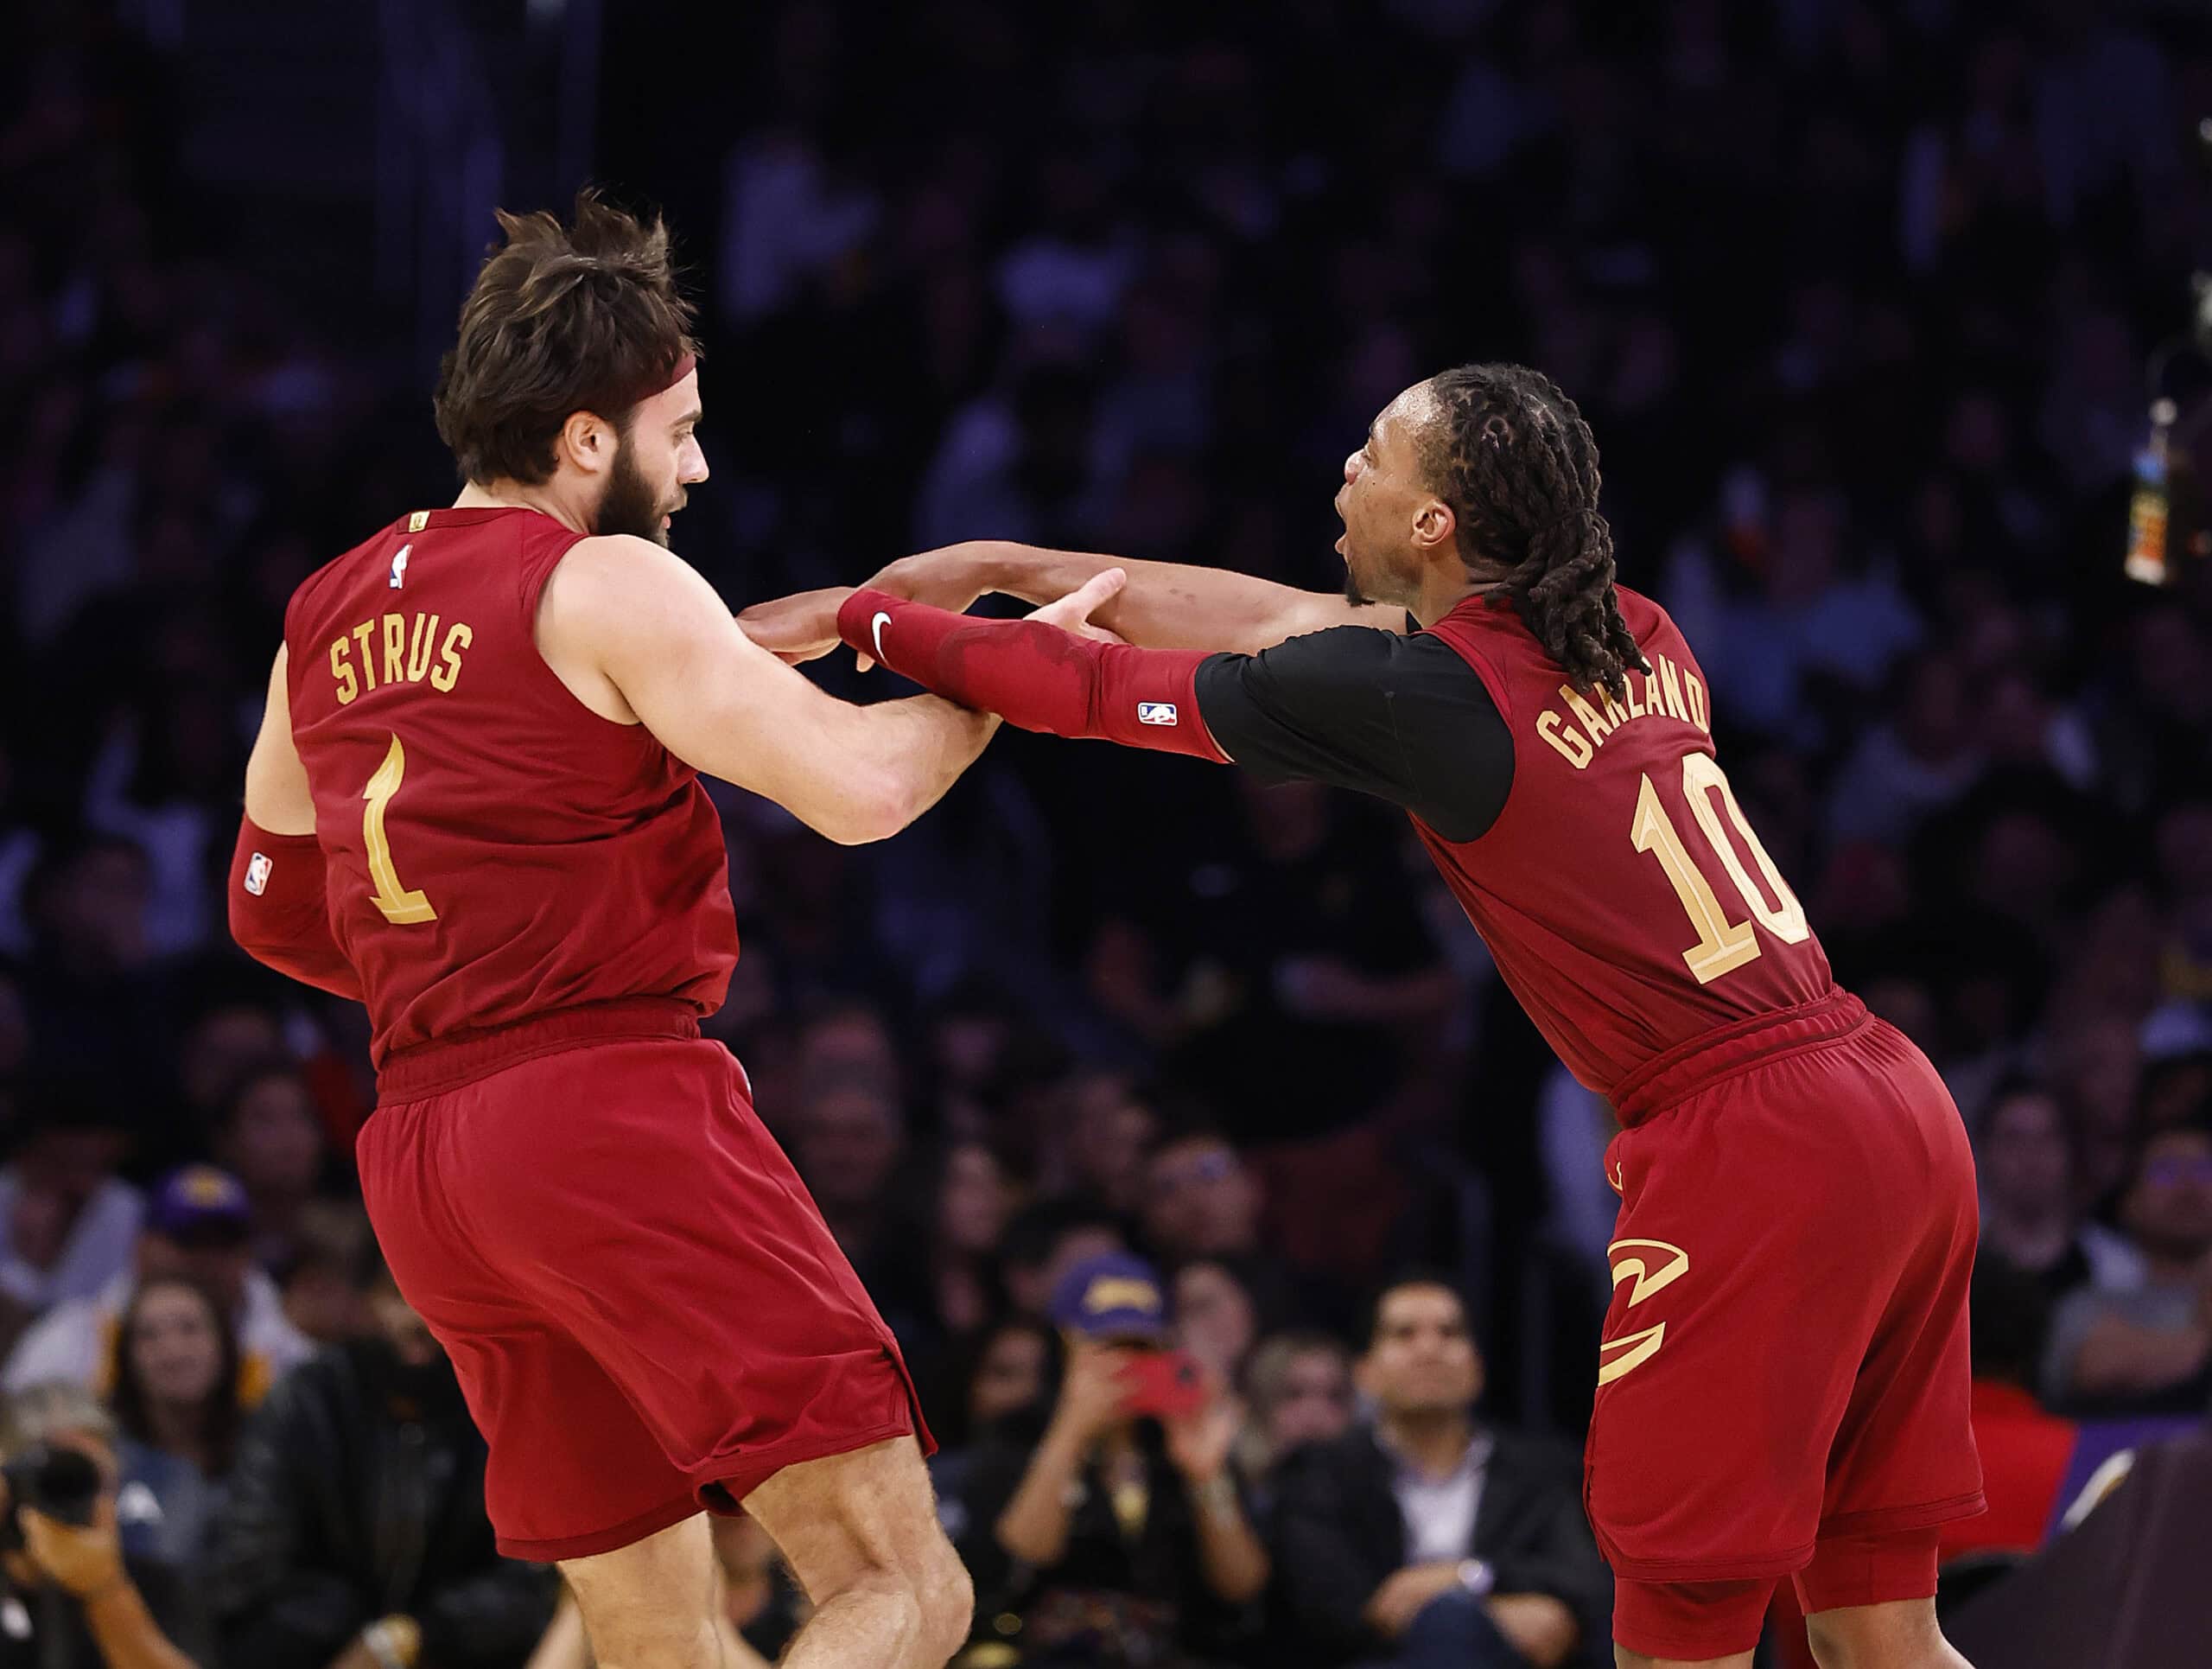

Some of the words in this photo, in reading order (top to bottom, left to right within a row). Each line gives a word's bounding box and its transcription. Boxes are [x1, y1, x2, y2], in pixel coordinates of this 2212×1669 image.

[329, 612, 473, 705] STRUS
[363, 732, 438, 925] 1
[1630, 751, 1810, 984] 10
